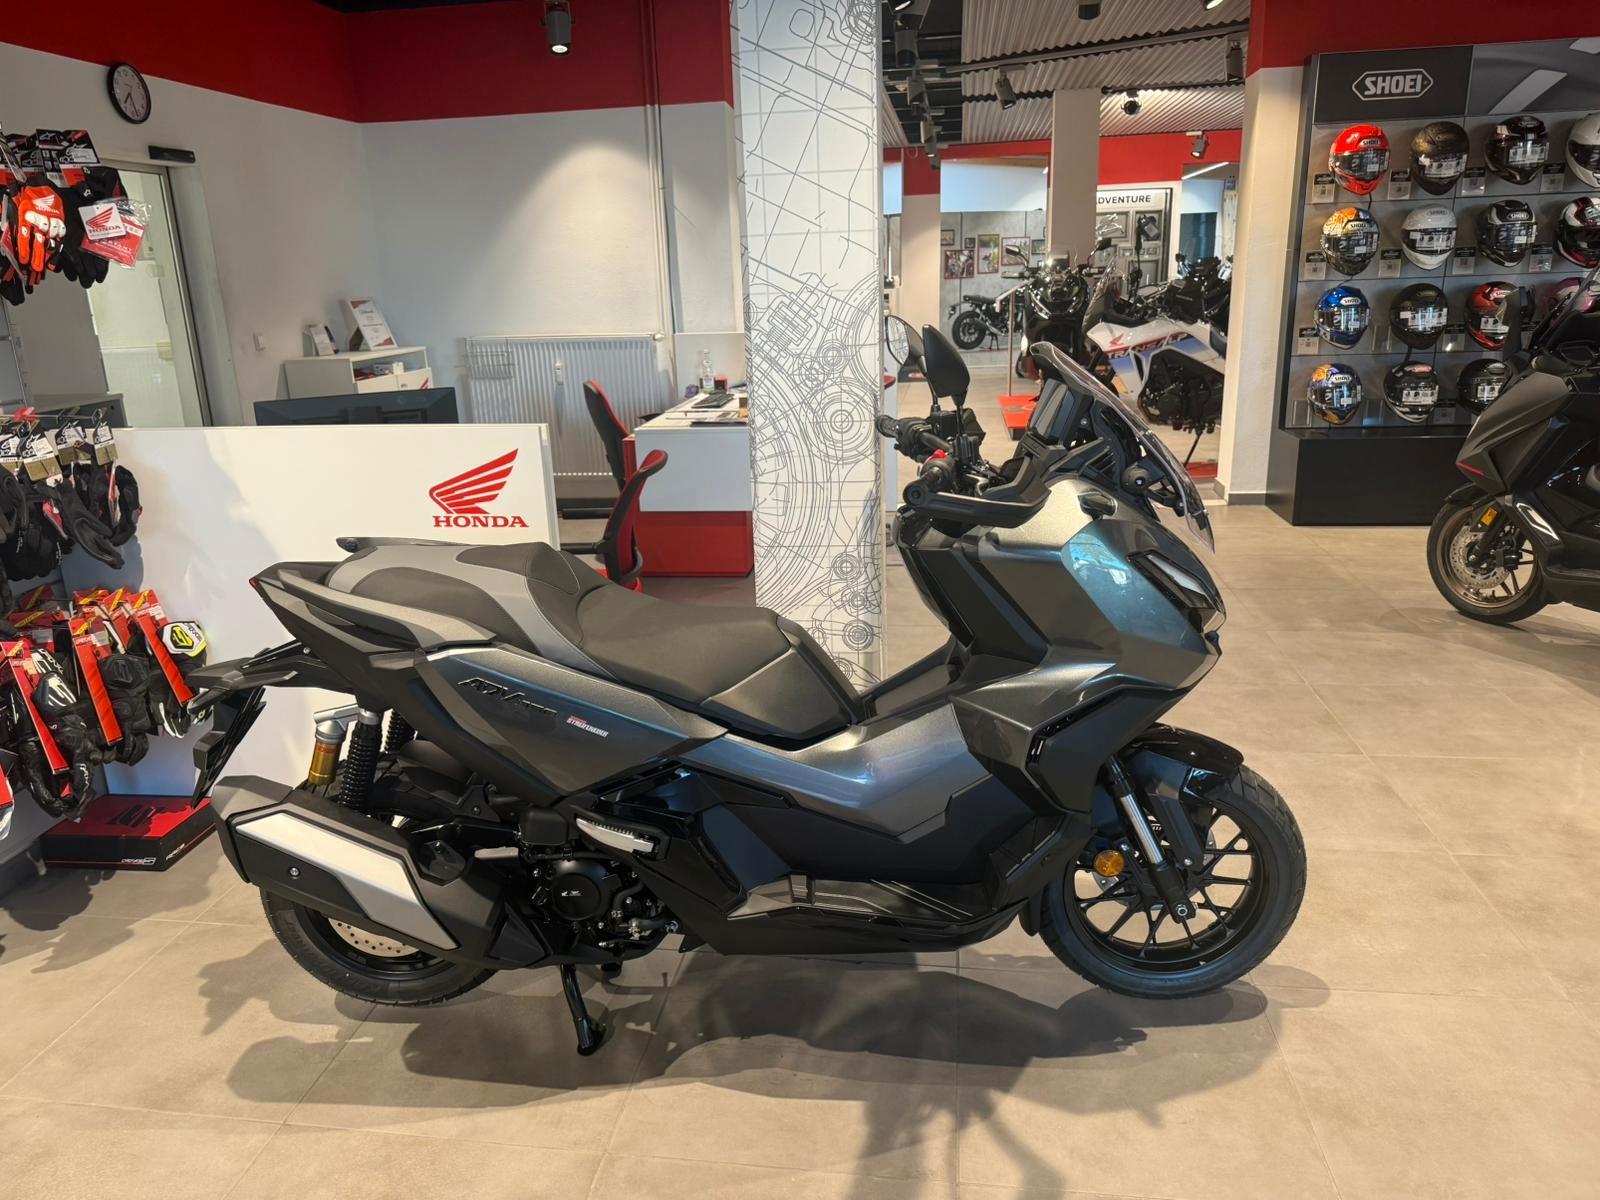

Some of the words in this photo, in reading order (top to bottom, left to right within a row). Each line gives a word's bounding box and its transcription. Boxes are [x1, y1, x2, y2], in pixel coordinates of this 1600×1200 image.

[1364, 74, 1423, 96] SHOEI
[1097, 194, 1151, 205] DVENTURE
[88, 225, 122, 234] HONDA
[432, 515, 528, 528] HONDA
